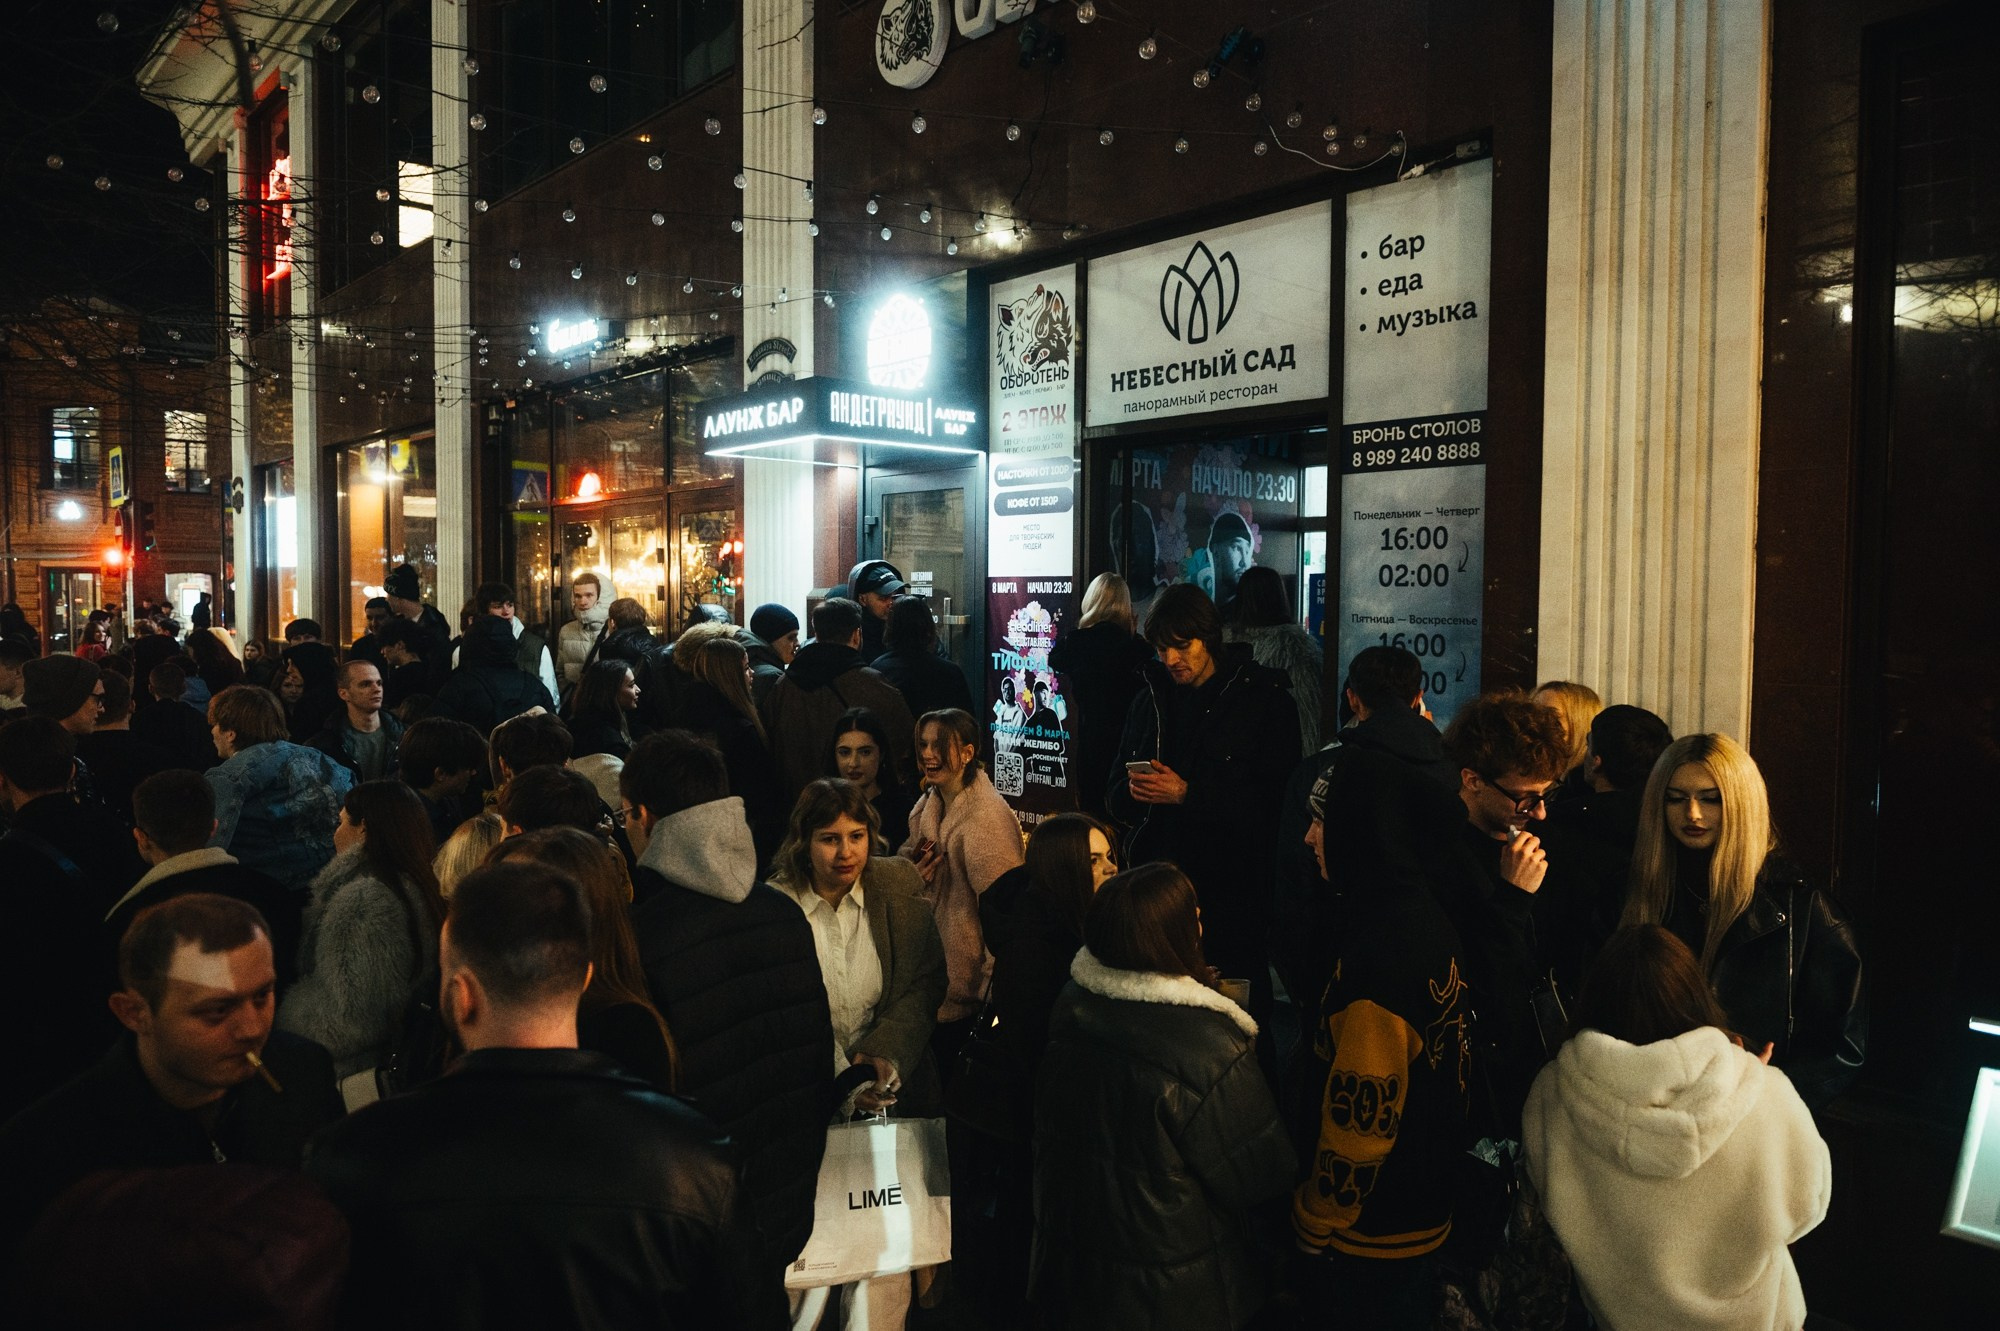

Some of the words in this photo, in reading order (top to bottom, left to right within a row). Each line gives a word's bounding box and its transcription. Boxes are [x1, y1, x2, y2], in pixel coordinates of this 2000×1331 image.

[1378, 234, 1425, 260] бар
[1377, 272, 1424, 298] еда
[1377, 300, 1478, 336] музыка
[1000, 366, 1070, 390] ОБОРОТЕНЬ
[1111, 348, 1237, 393] НЕБЕСНЫЙ
[1243, 344, 1296, 372] САД
[1123, 390, 1207, 414] панорамный
[1209, 382, 1278, 405] ресторан
[703, 405, 764, 438] ЛАУНЖ
[766, 397, 804, 427] БАР
[830, 391, 925, 434] АНДЕГРАУНД
[934, 407, 976, 423] ЛАУНЖ
[1002, 411, 1012, 432] 2
[1018, 403, 1067, 430] ЭТАЖ
[944, 422, 967, 435] БАР
[1352, 427, 1405, 445] БРОНЬ
[1409, 418, 1481, 440] СТОЛОВ
[1352, 451, 1362, 467] 8
[1366, 449, 1396, 466] 989
[1400, 446, 1432, 464] 240
[1437, 441, 1480, 461] 8888
[997, 467, 1039, 481] НАСТОЙКИ
[1039, 466, 1050, 477] ОТ
[1110, 457, 1162, 490] МРТА
[1191, 464, 1252, 499] НАЧАЛО
[1256, 472, 1295, 503] 23:30
[1007, 497, 1029, 509] КОФЕ
[1029, 497, 1041, 507] ОТ
[1041, 495, 1059, 506] 150Р
[1353, 509, 1422, 521] Понедельник
[1436, 506, 1481, 518] Четверг
[1380, 526, 1449, 551] 16:00
[1379, 563, 1450, 587] 02:00
[992, 582, 997, 593] 8
[997, 582, 1018, 593] МАРТА
[1027, 581, 1053, 593] НАЧАЛО
[1053, 581, 1072, 594] 23:30
[1010, 620, 1053, 633] Headliner
[1351, 613, 1395, 626] Пятница
[1409, 614, 1478, 626] Воскресенье
[1379, 632, 1446, 657] 16:00
[992, 652, 1053, 673] ТИФФА
[990, 723, 1035, 736] ПРАЗДНУЕМ
[1036, 725, 1043, 737] 8
[1044, 729, 1071, 740] МАРТА
[1024, 739, 1060, 751] ЖЕЛИБО
